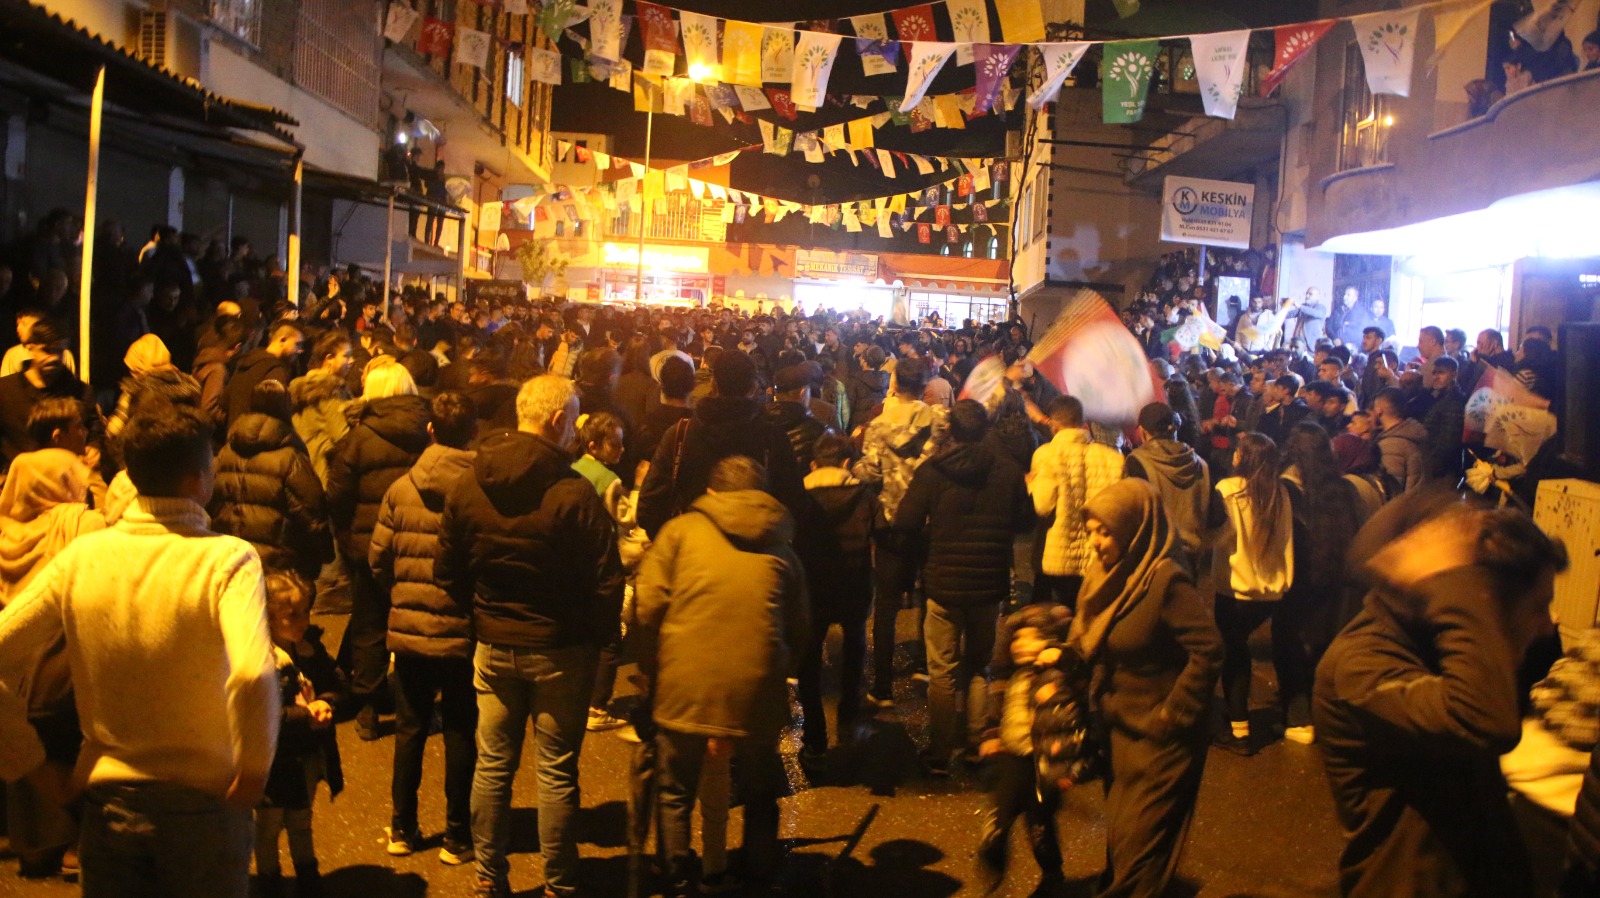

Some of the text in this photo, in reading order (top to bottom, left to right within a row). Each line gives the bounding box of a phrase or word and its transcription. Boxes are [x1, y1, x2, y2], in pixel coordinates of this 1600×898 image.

[1181, 190, 1189, 200] K
[1201, 191, 1247, 206] KESKİN
[1180, 201, 1190, 209] M
[1200, 205, 1245, 218] MOBİLYA
